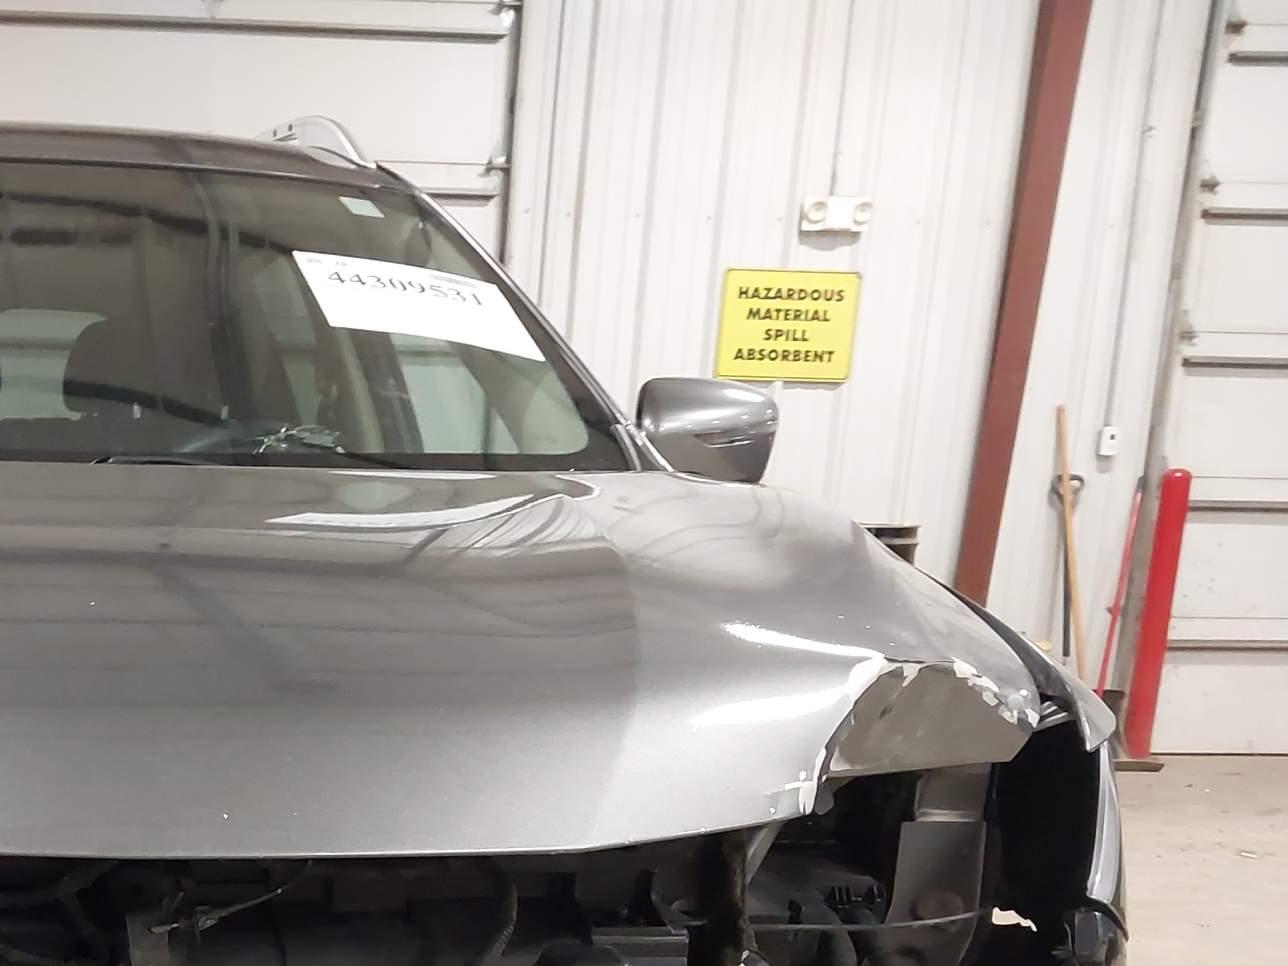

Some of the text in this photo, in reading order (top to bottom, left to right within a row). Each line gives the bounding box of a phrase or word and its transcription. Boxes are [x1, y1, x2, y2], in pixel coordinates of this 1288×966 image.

[328, 271, 483, 306] 44309531
[738, 286, 845, 302] HAZARDOUS
[746, 307, 830, 322] MATERIAL
[763, 328, 809, 342] SPILL
[733, 348, 835, 363] ABSORBENT
